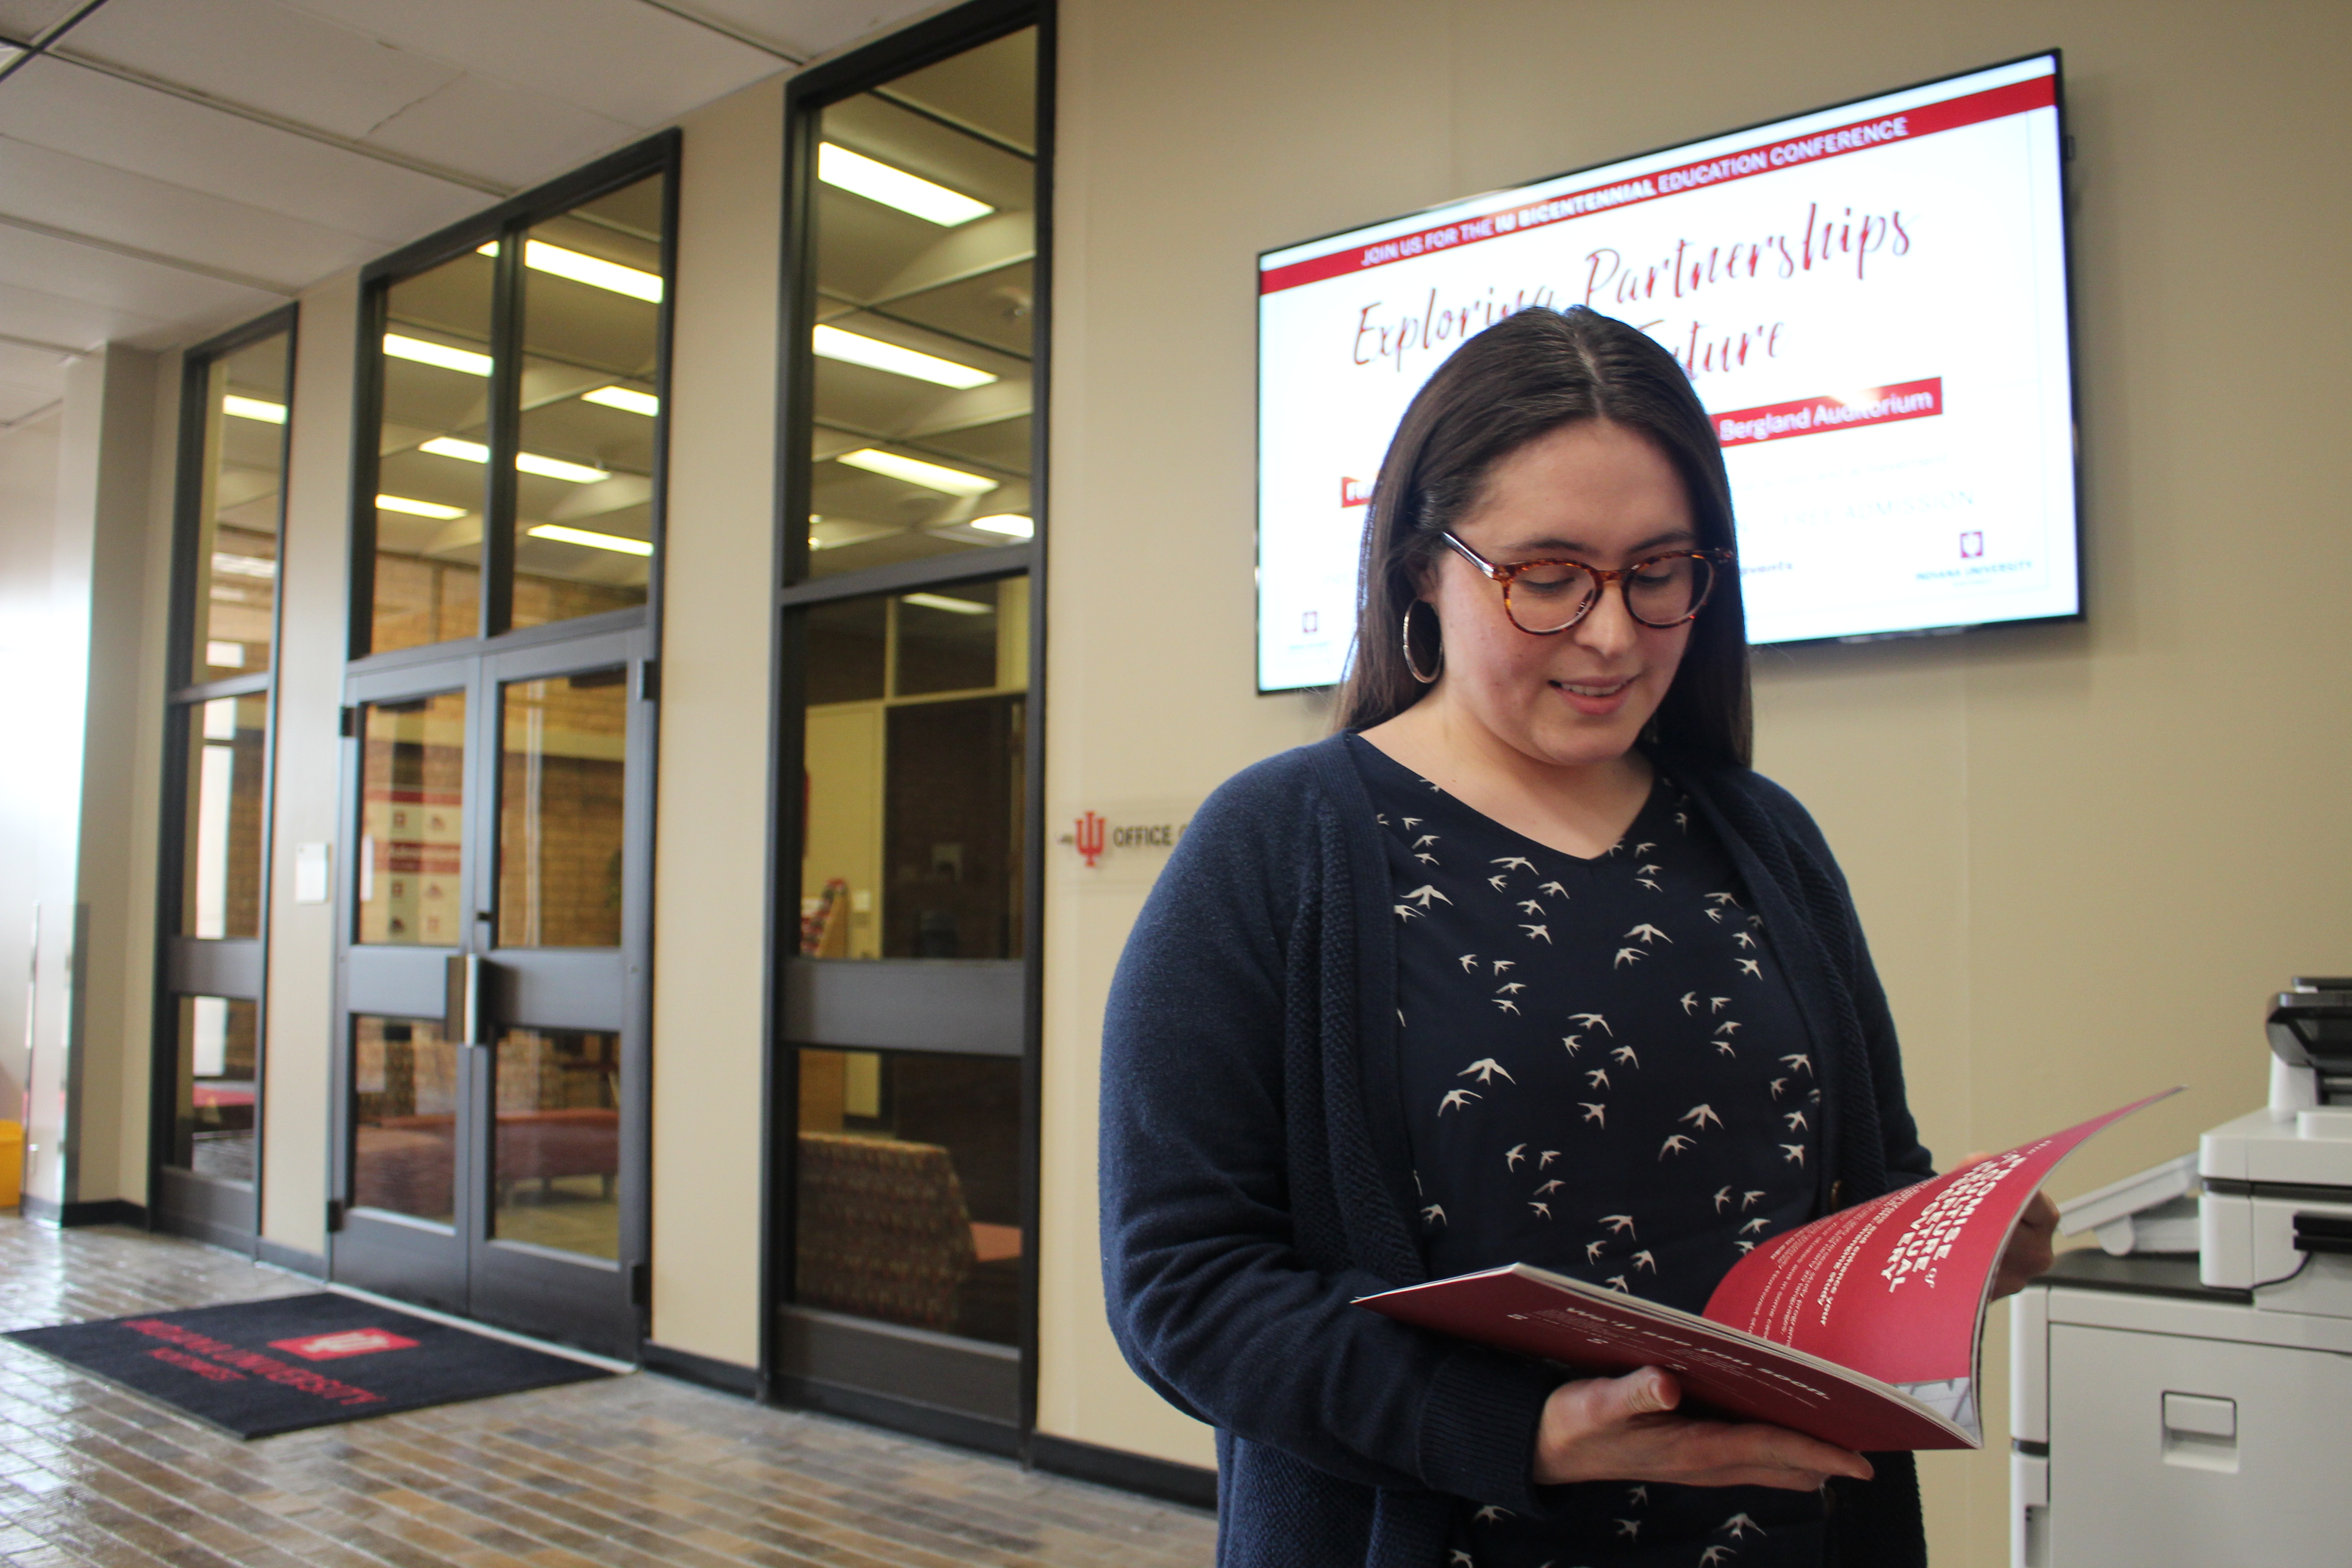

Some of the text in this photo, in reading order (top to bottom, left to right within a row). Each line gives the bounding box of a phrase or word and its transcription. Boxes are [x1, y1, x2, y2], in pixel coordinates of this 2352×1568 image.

[1361, 117, 1909, 267] JOIN US FOR THE IU BICENTENNIAL EDUCATION CONFERENCE
[1585, 202, 1911, 307] Partnerships
[1720, 392, 1934, 441] Bergland Auditorium
[1113, 825, 1173, 847] OFFICE
[1880, 1160, 1994, 1281] DISCOVERY
[1888, 1161, 1999, 1293] PERPETUAL
[1911, 1168, 2001, 1273] CULTURE
[1924, 1156, 2027, 1289] PROMISE of
[1817, 1271, 1837, 1306] study
[1820, 1296, 1834, 1326] your
[1566, 1307, 1636, 1330] We'll
[1694, 1348, 1752, 1366] you
[1756, 1367, 1831, 1400] soon.
